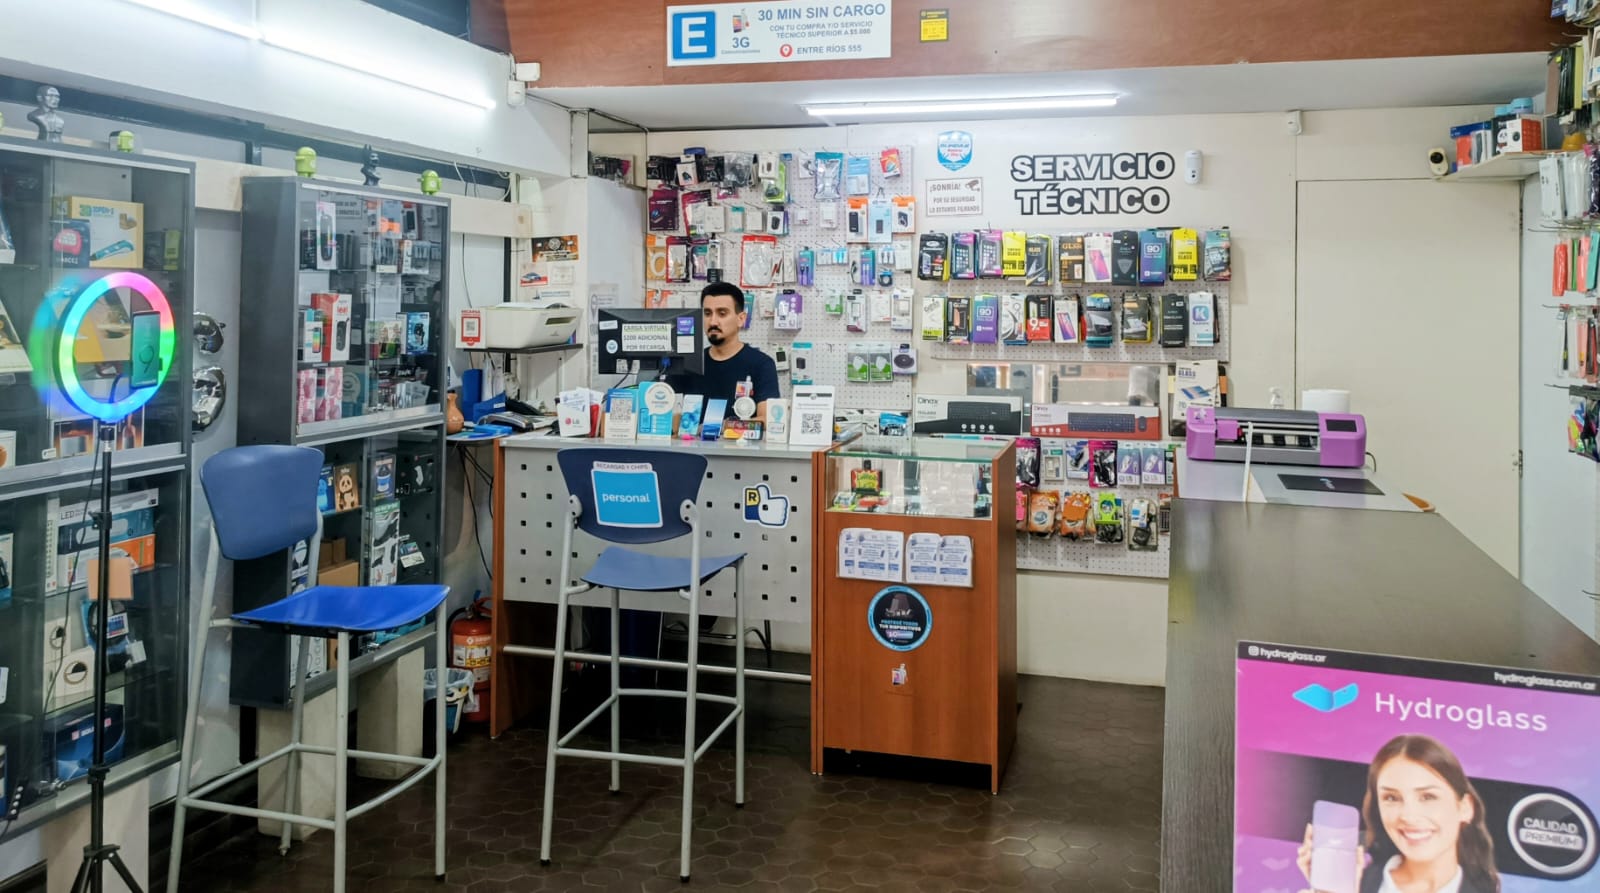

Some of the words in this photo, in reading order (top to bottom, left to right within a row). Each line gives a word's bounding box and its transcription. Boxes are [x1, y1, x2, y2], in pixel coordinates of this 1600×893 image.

[758, 10, 773, 21] 30
[777, 8, 802, 20] MIN
[806, 6, 829, 19] SIN
[833, 3, 886, 17] CARGO
[840, 20, 873, 28] SERVICIO
[681, 16, 708, 54] E
[732, 37, 750, 48] 3G
[797, 46, 824, 55] ENTRE
[826, 44, 847, 53] RÍOS
[1010, 151, 1175, 182] SERVICIO
[1015, 183, 1170, 215] TÉCNICO
[602, 493, 650, 503] personal
[747, 491, 757, 502] R
[60, 510, 74, 520] LED
[1260, 647, 1326, 663] hydroglass.ar
[1494, 671, 1597, 691] hydroglass.com.ar
[1375, 692, 1548, 732] Hydroglass
[1523, 817, 1578, 834] CALIDAD
[1525, 831, 1577, 846] PREMIUM
